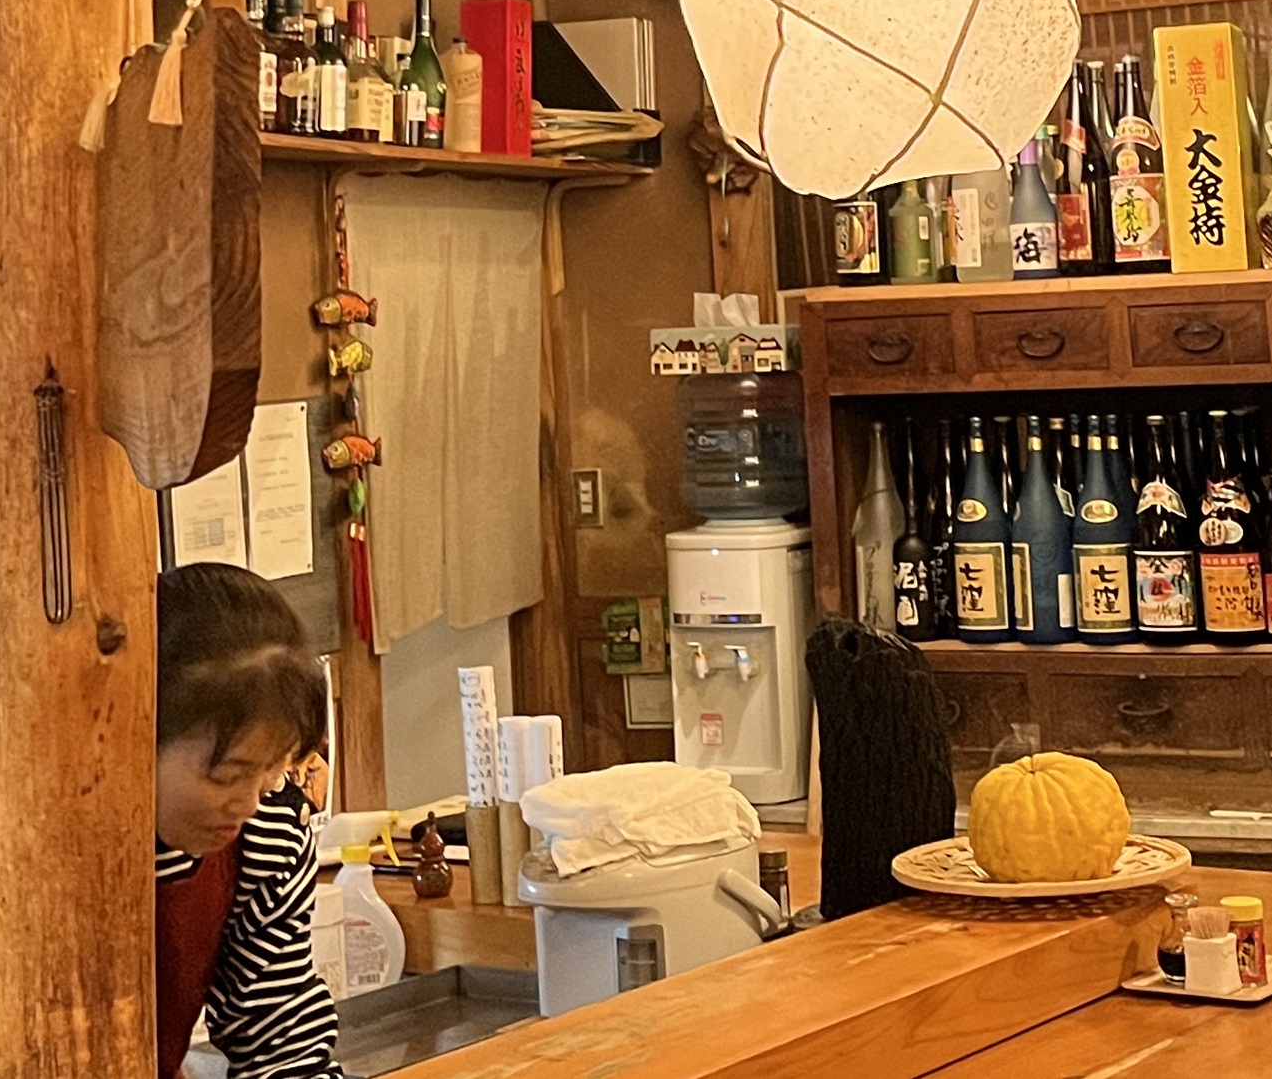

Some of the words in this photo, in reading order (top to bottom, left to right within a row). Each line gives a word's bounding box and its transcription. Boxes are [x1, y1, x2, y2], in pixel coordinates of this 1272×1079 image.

[1185, 56, 1209, 117] 金箔入
[1014, 227, 1042, 264] 海
